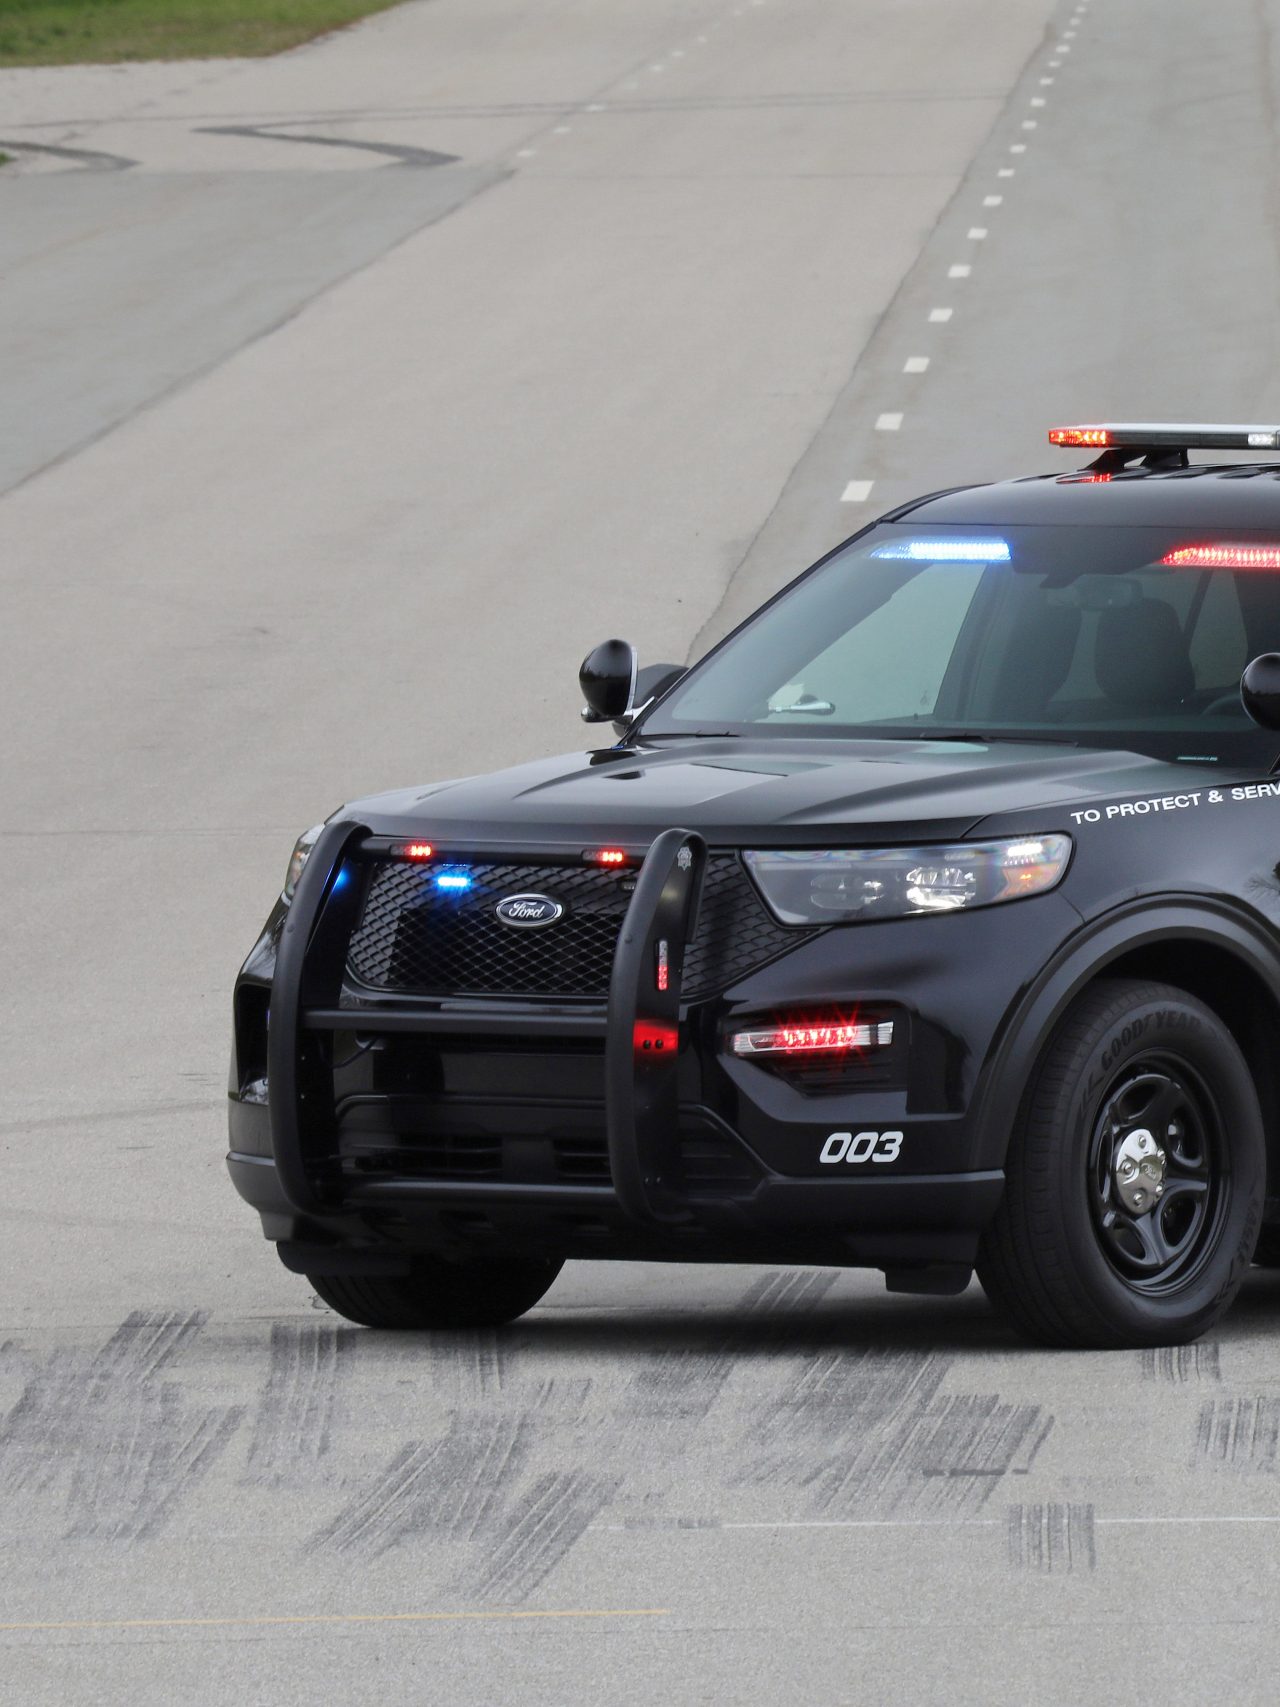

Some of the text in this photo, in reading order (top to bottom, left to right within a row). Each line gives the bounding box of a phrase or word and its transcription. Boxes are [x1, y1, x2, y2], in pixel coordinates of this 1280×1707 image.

[1070, 808, 1101, 825] TO
[1106, 793, 1202, 819] PROTECT
[1207, 789, 1224, 803] &
[508, 900, 546, 919] Ford
[819, 1131, 904, 1164] 003
